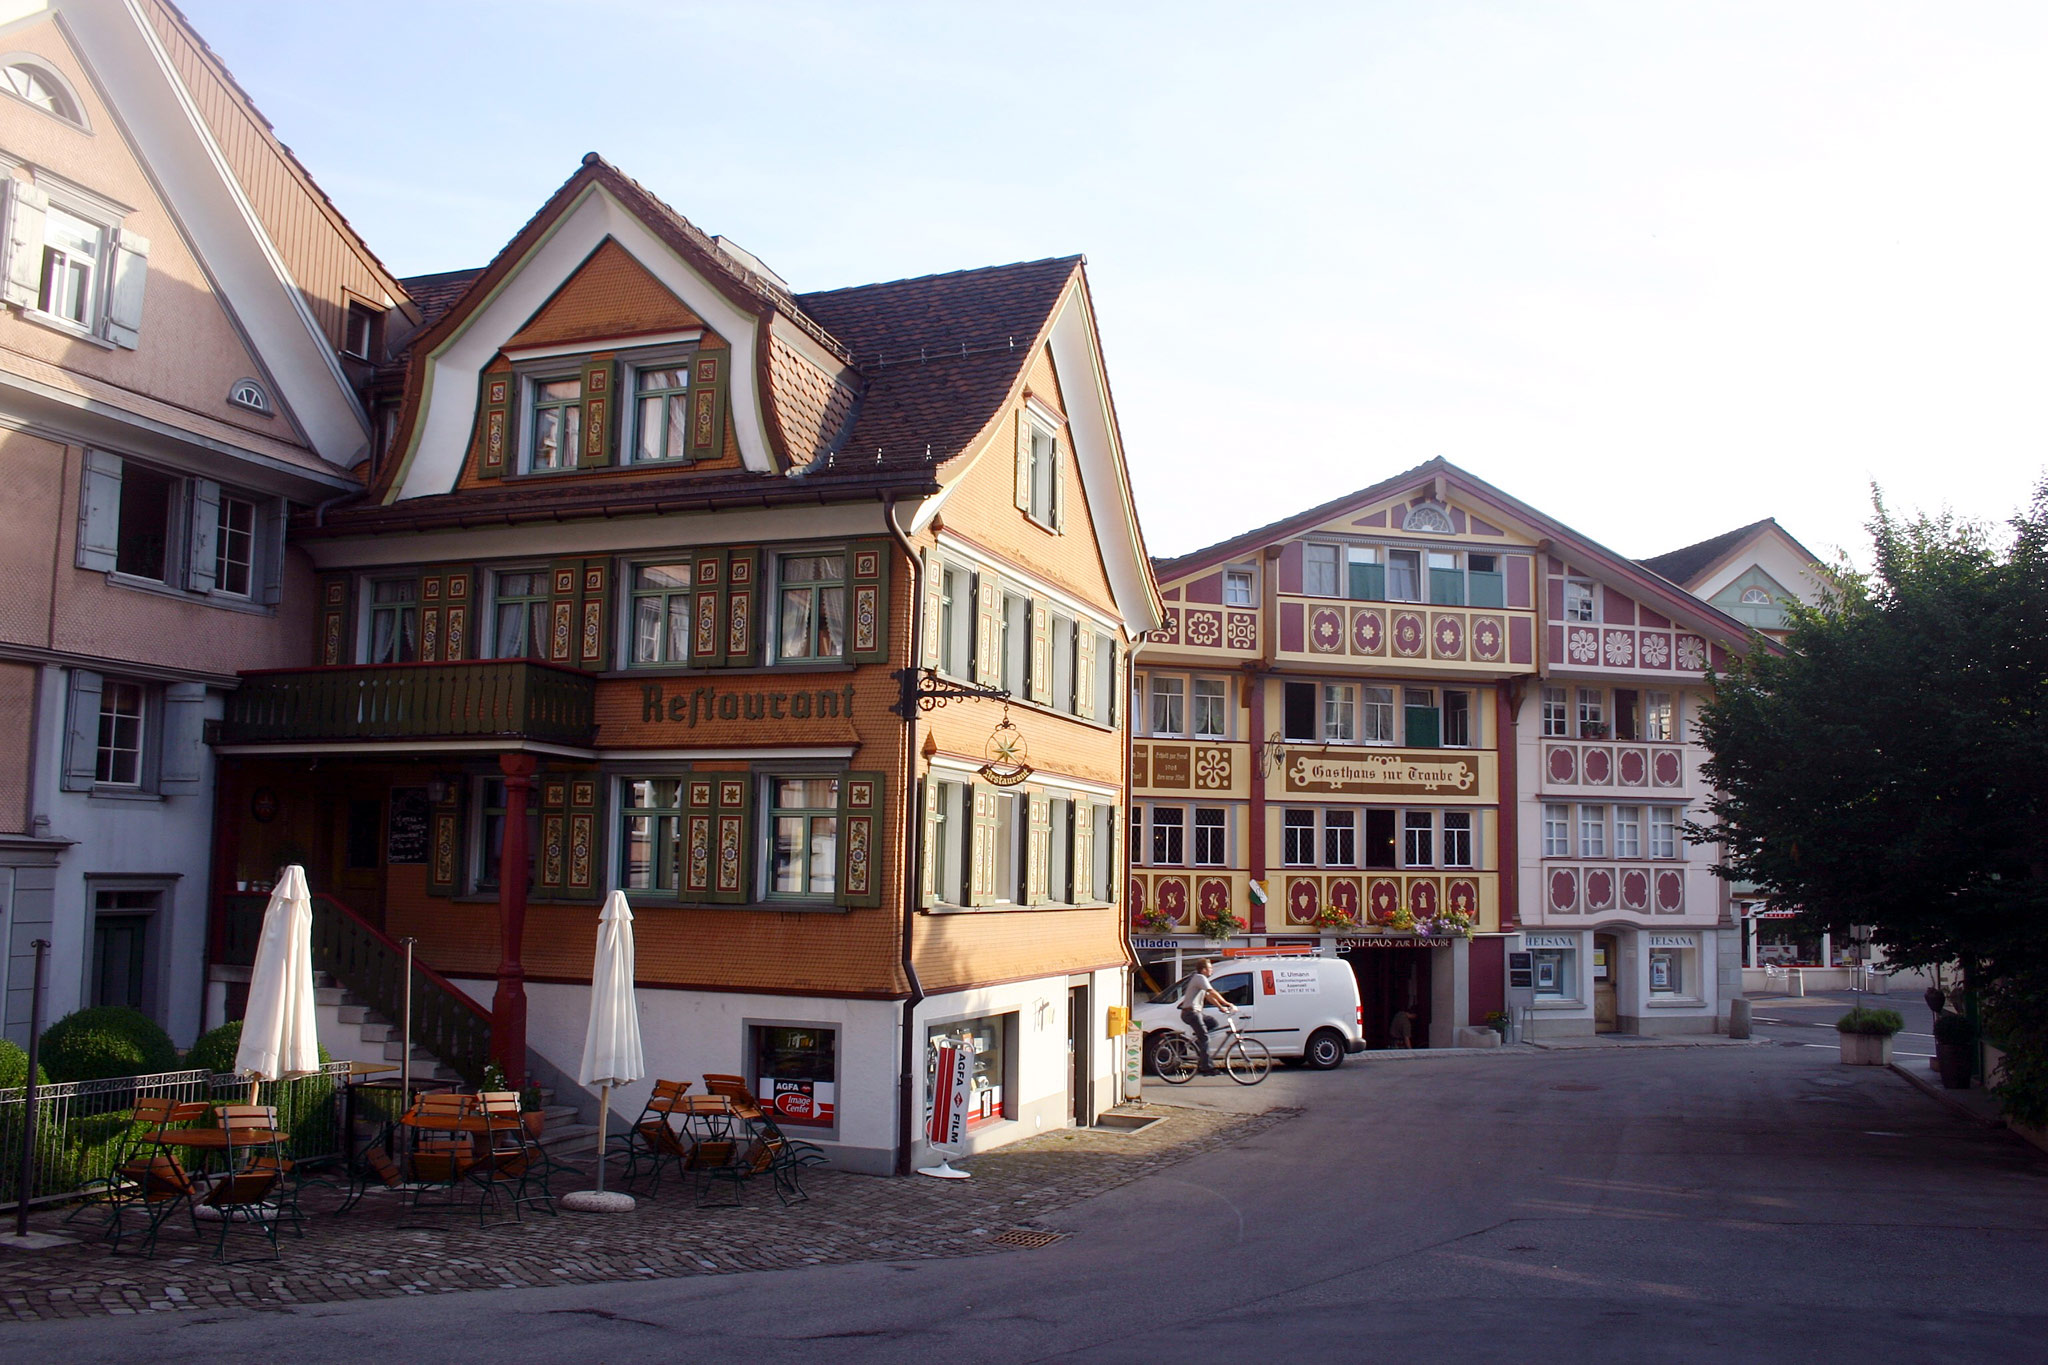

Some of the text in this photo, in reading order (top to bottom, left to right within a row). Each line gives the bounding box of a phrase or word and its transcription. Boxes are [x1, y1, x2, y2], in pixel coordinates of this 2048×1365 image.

[983, 768, 1030, 786] Restaurant
[1312, 765, 1453, 783] Gasthaus zur Traube
[1132, 939, 1178, 948] eltladen
[1337, 938, 1392, 948] GASTHAUS
[1413, 938, 1450, 947] TRAUBE
[1526, 937, 1574, 947] HELSANA
[956, 1053, 966, 1086] AGFA
[776, 1082, 799, 1092] AGFA
[788, 1095, 811, 1106] Image
[786, 1103, 810, 1113] Center
[950, 1113, 960, 1143] FILM
